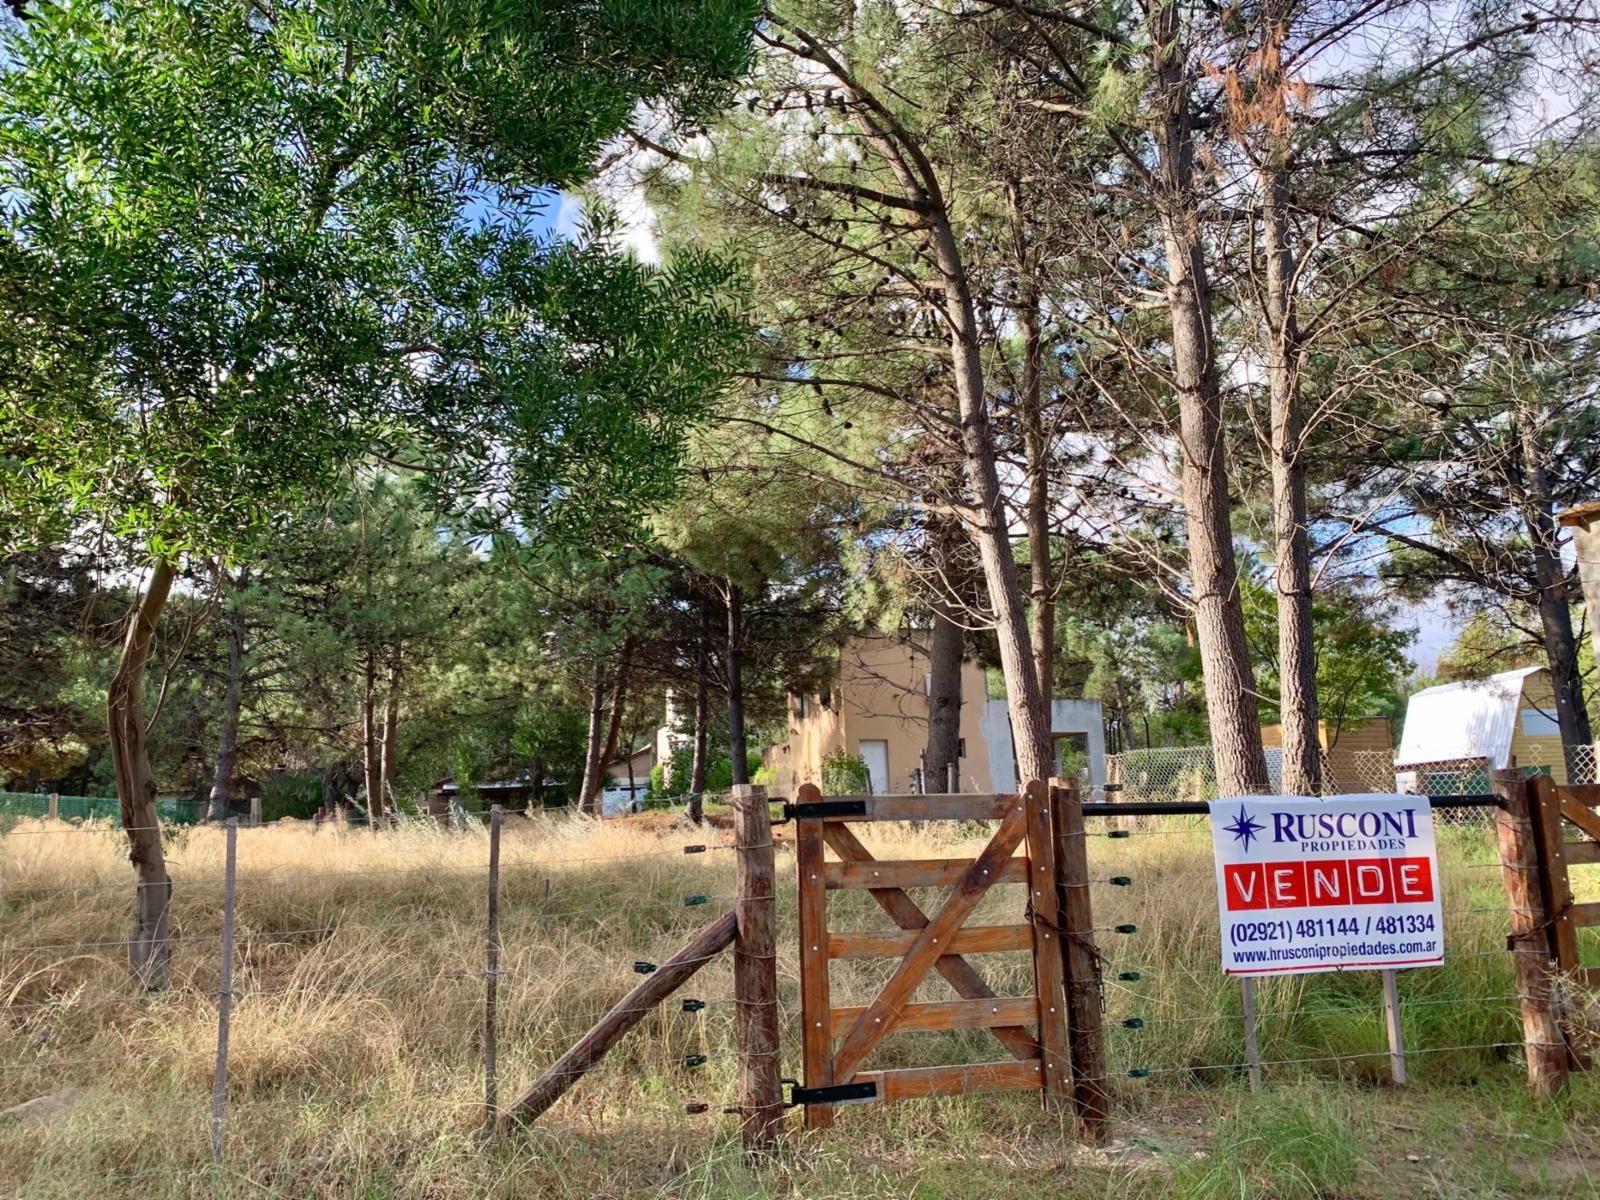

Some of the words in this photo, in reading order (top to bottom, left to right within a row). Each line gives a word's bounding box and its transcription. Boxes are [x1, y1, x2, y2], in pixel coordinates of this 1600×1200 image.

[1271, 809, 1418, 842] RUSCONI
[1301, 838, 1406, 852] PROPIEDADES
[1233, 865, 1424, 903] VENDE
[1230, 920, 1292, 946] (02921)
[1296, 917, 1359, 938] 481144
[1375, 914, 1435, 935] 481334
[1233, 940, 1437, 963] www.hrusconipropiedades.com.ar
